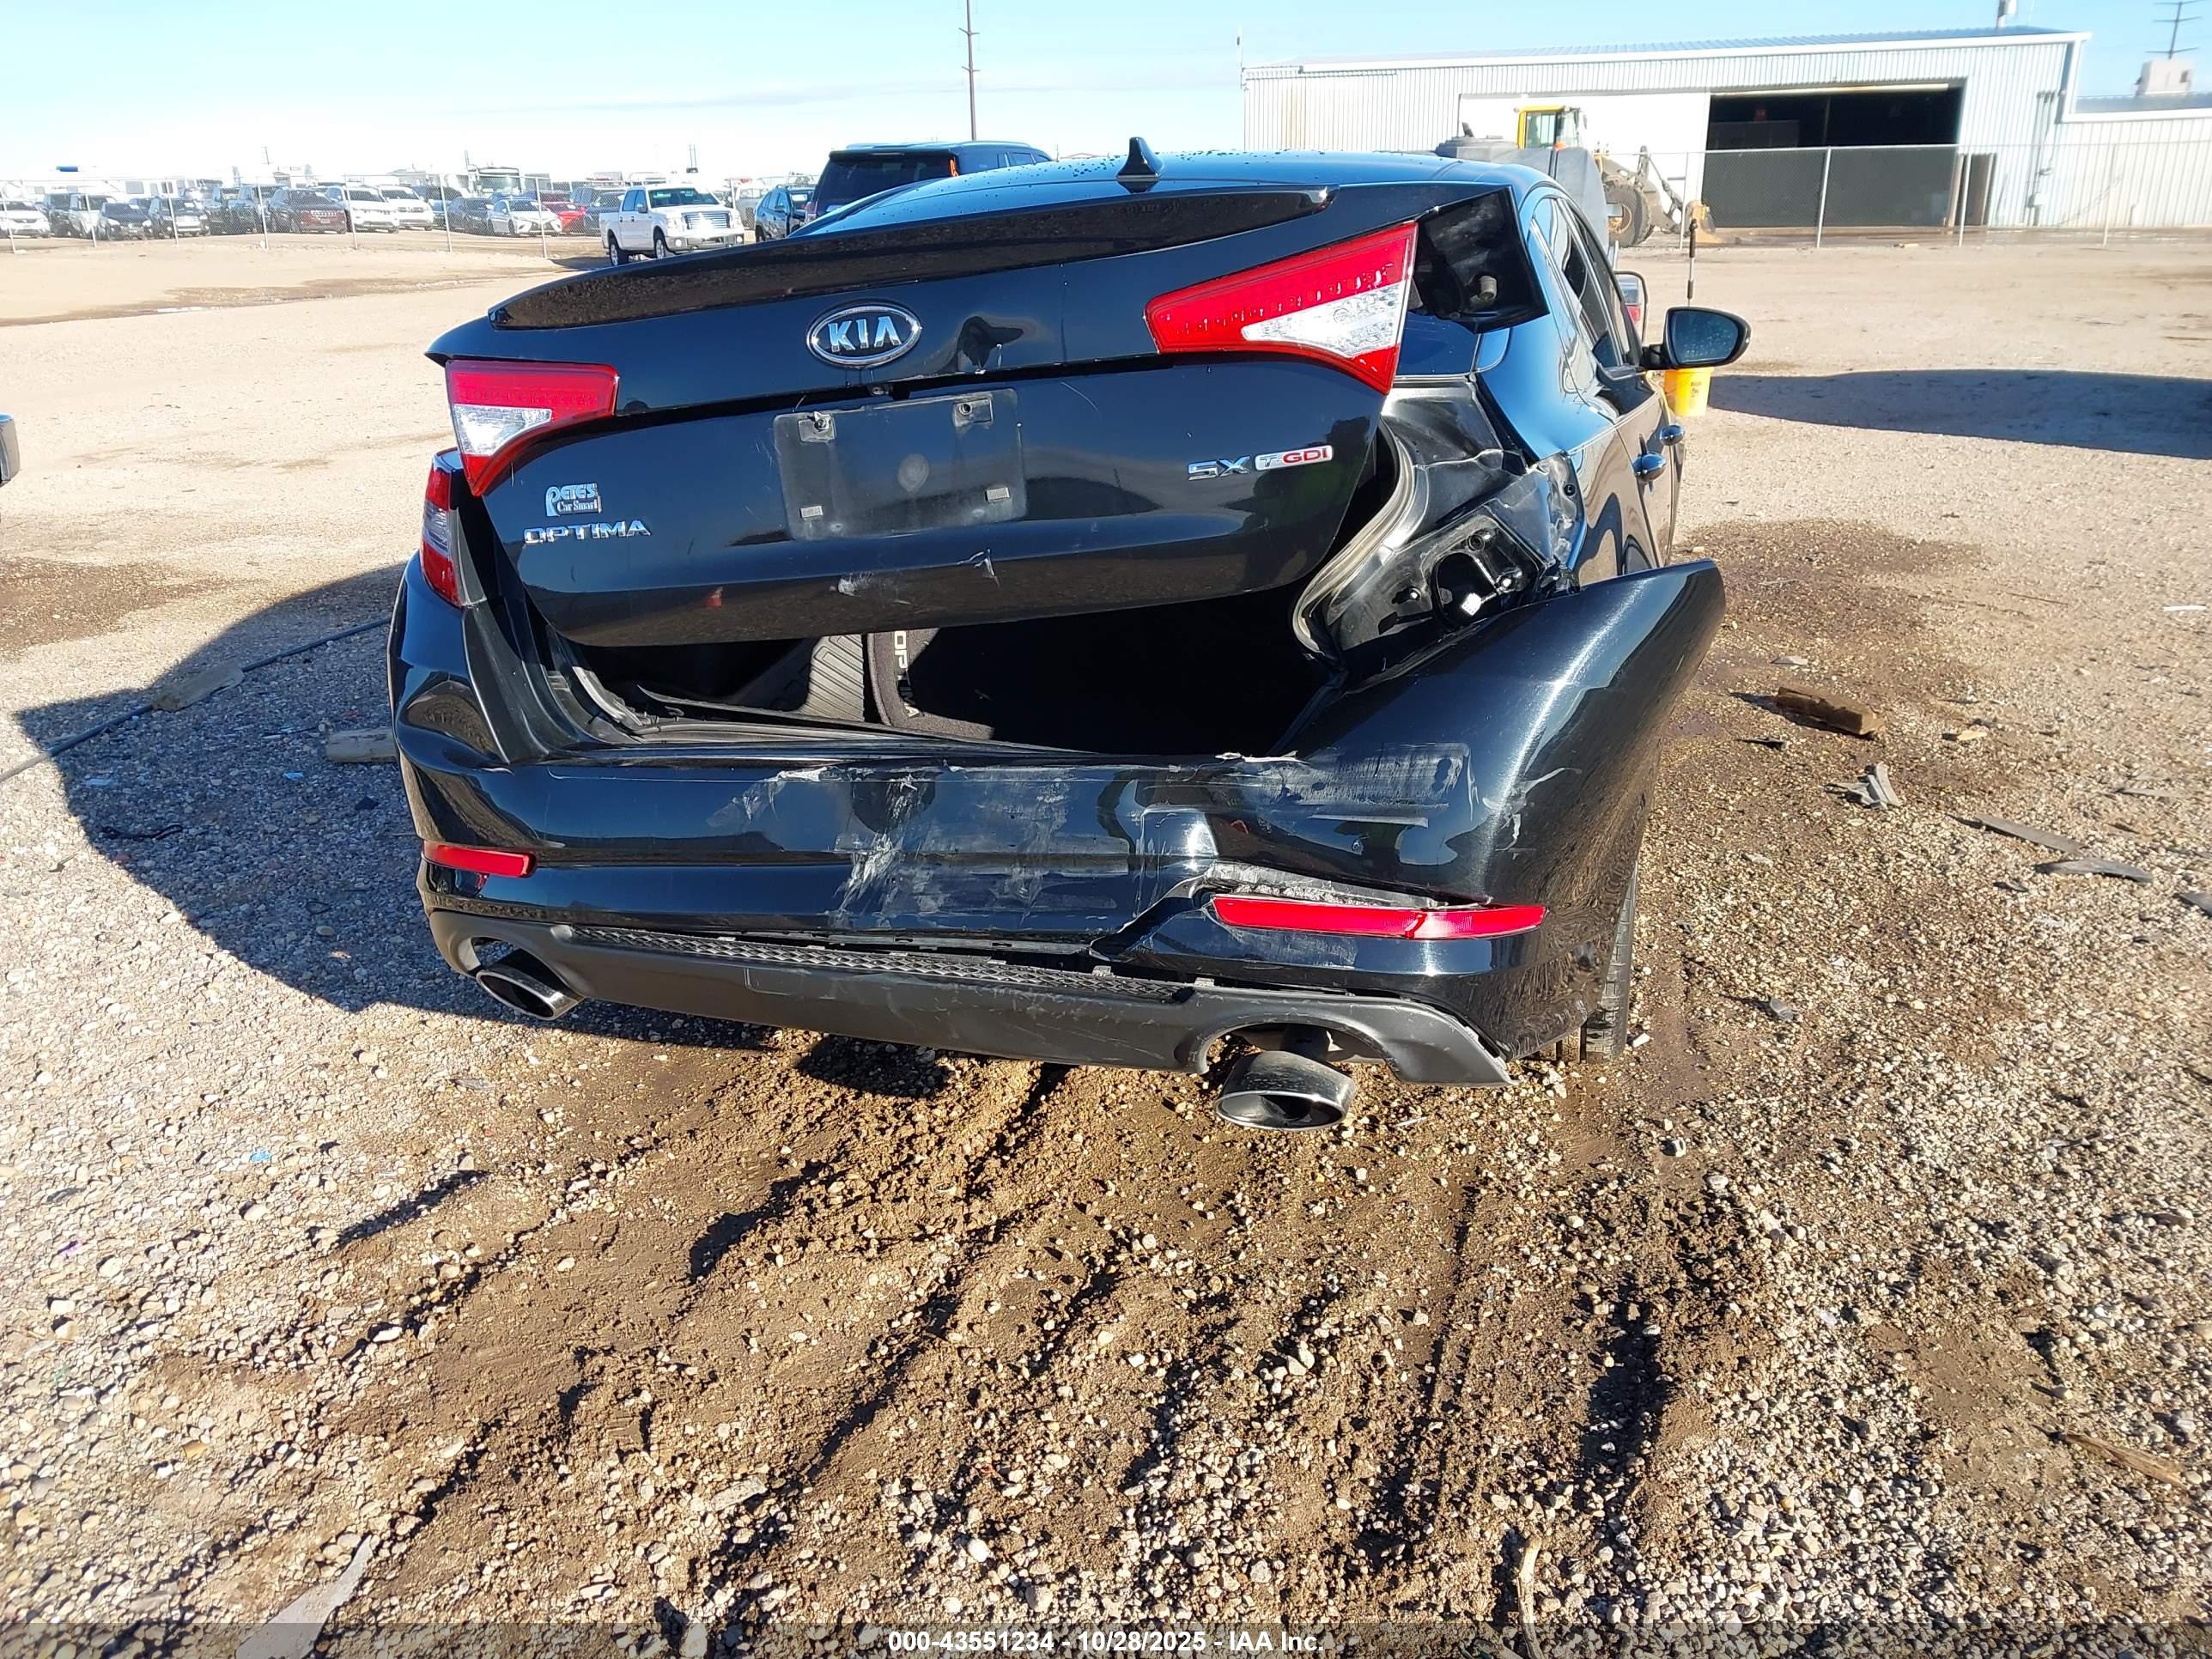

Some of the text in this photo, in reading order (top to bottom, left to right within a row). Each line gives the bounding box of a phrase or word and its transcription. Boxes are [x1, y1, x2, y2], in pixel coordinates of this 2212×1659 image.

[828, 315, 902, 353] KIA
[1188, 454, 1250, 481] SX
[556, 498, 599, 513] Car Smart
[524, 520, 650, 544] OPTIMA
